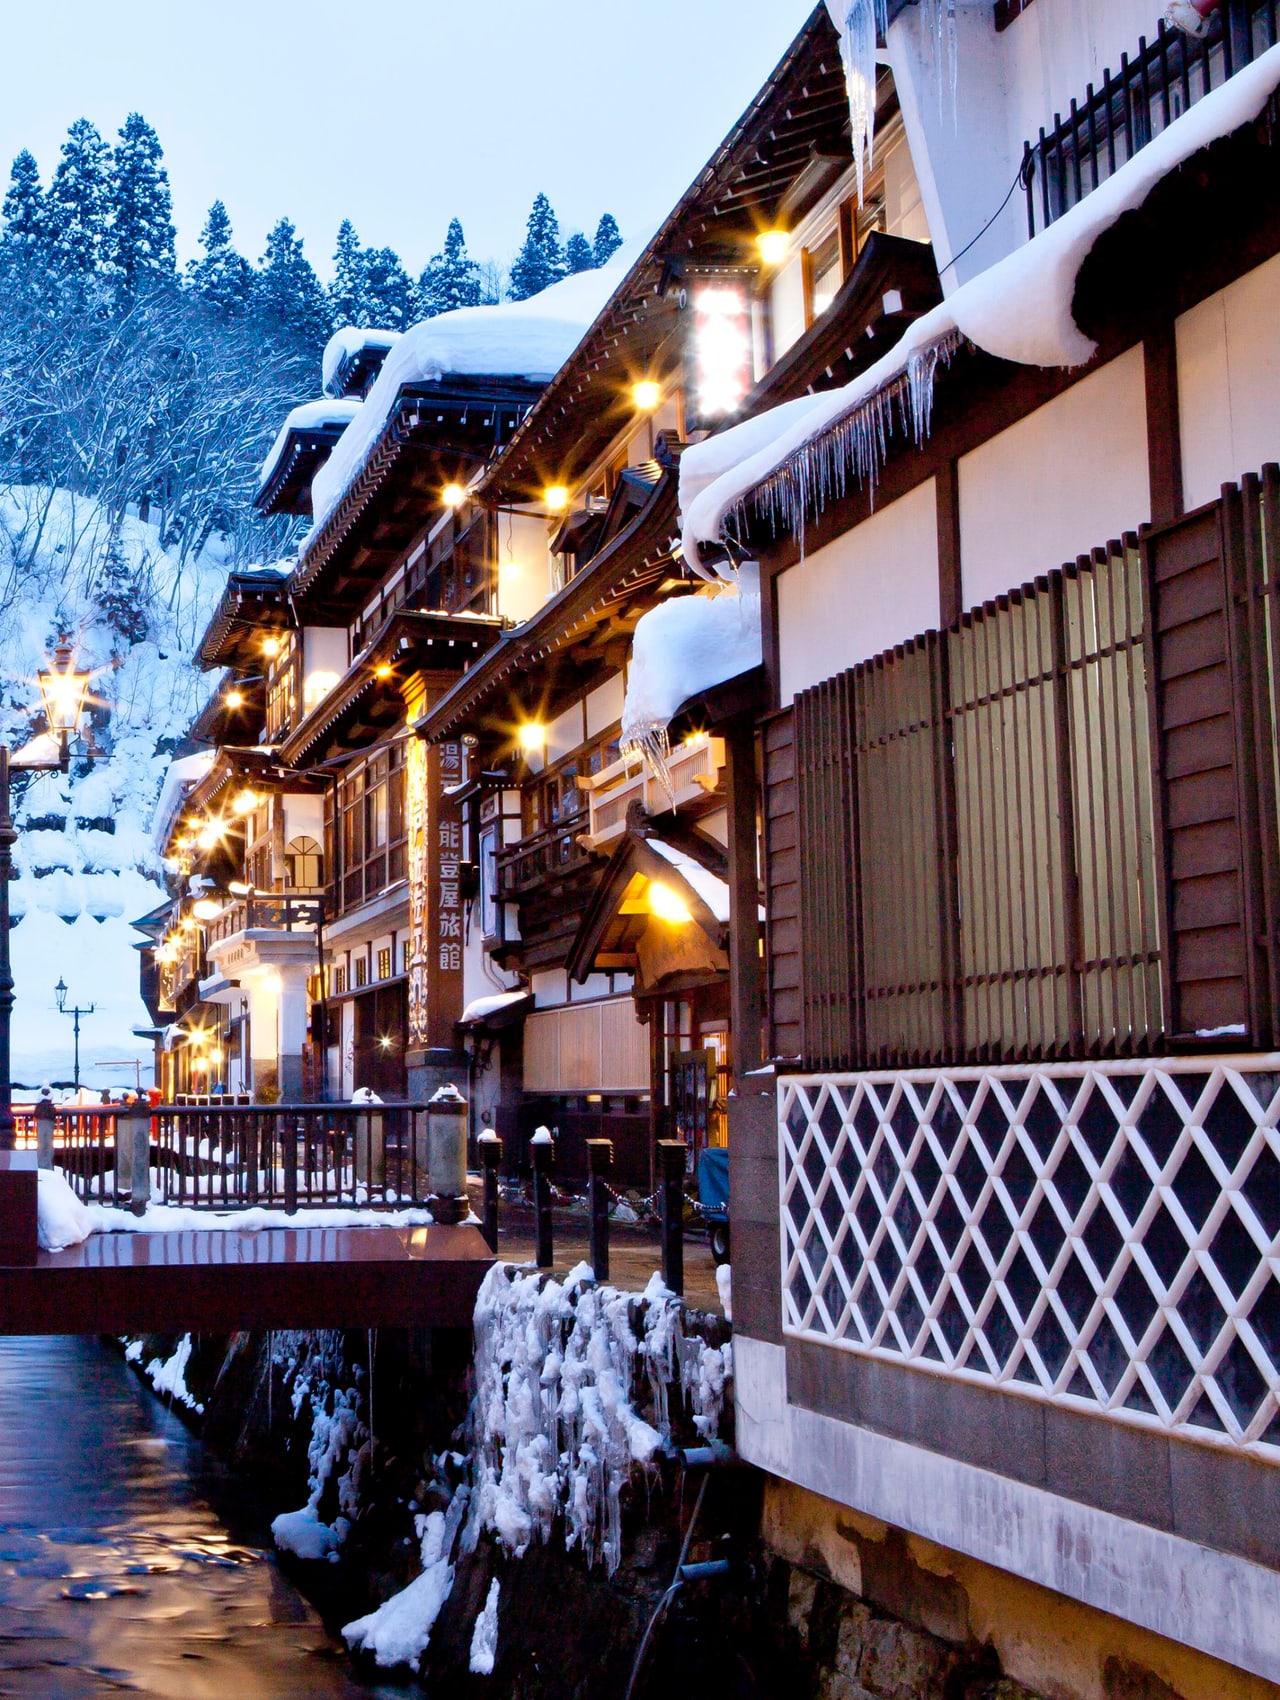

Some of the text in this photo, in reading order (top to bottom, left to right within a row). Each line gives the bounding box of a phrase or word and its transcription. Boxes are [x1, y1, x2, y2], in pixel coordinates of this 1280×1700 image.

[438, 822, 461, 971] 能登屋旅館
